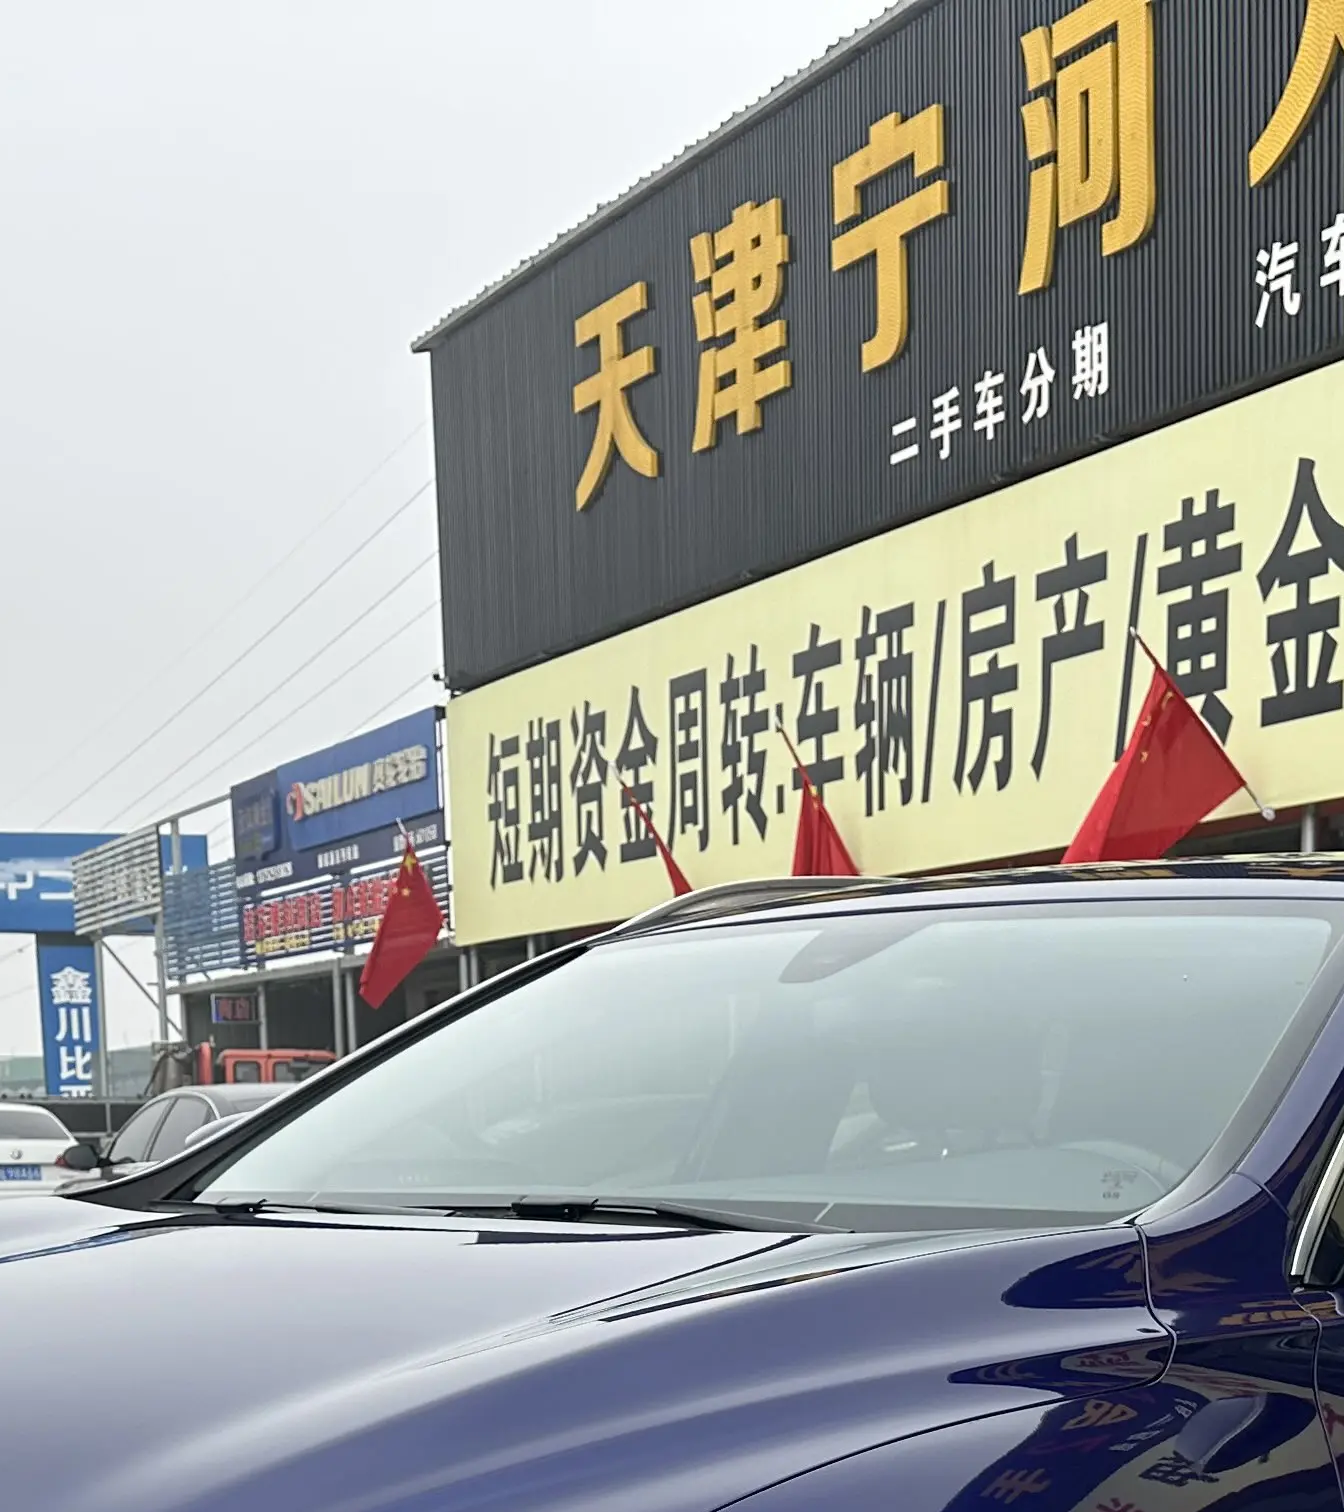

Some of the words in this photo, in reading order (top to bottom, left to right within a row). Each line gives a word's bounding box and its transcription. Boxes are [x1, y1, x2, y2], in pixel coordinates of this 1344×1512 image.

[889, 322, 1111, 466] 二手车分期
